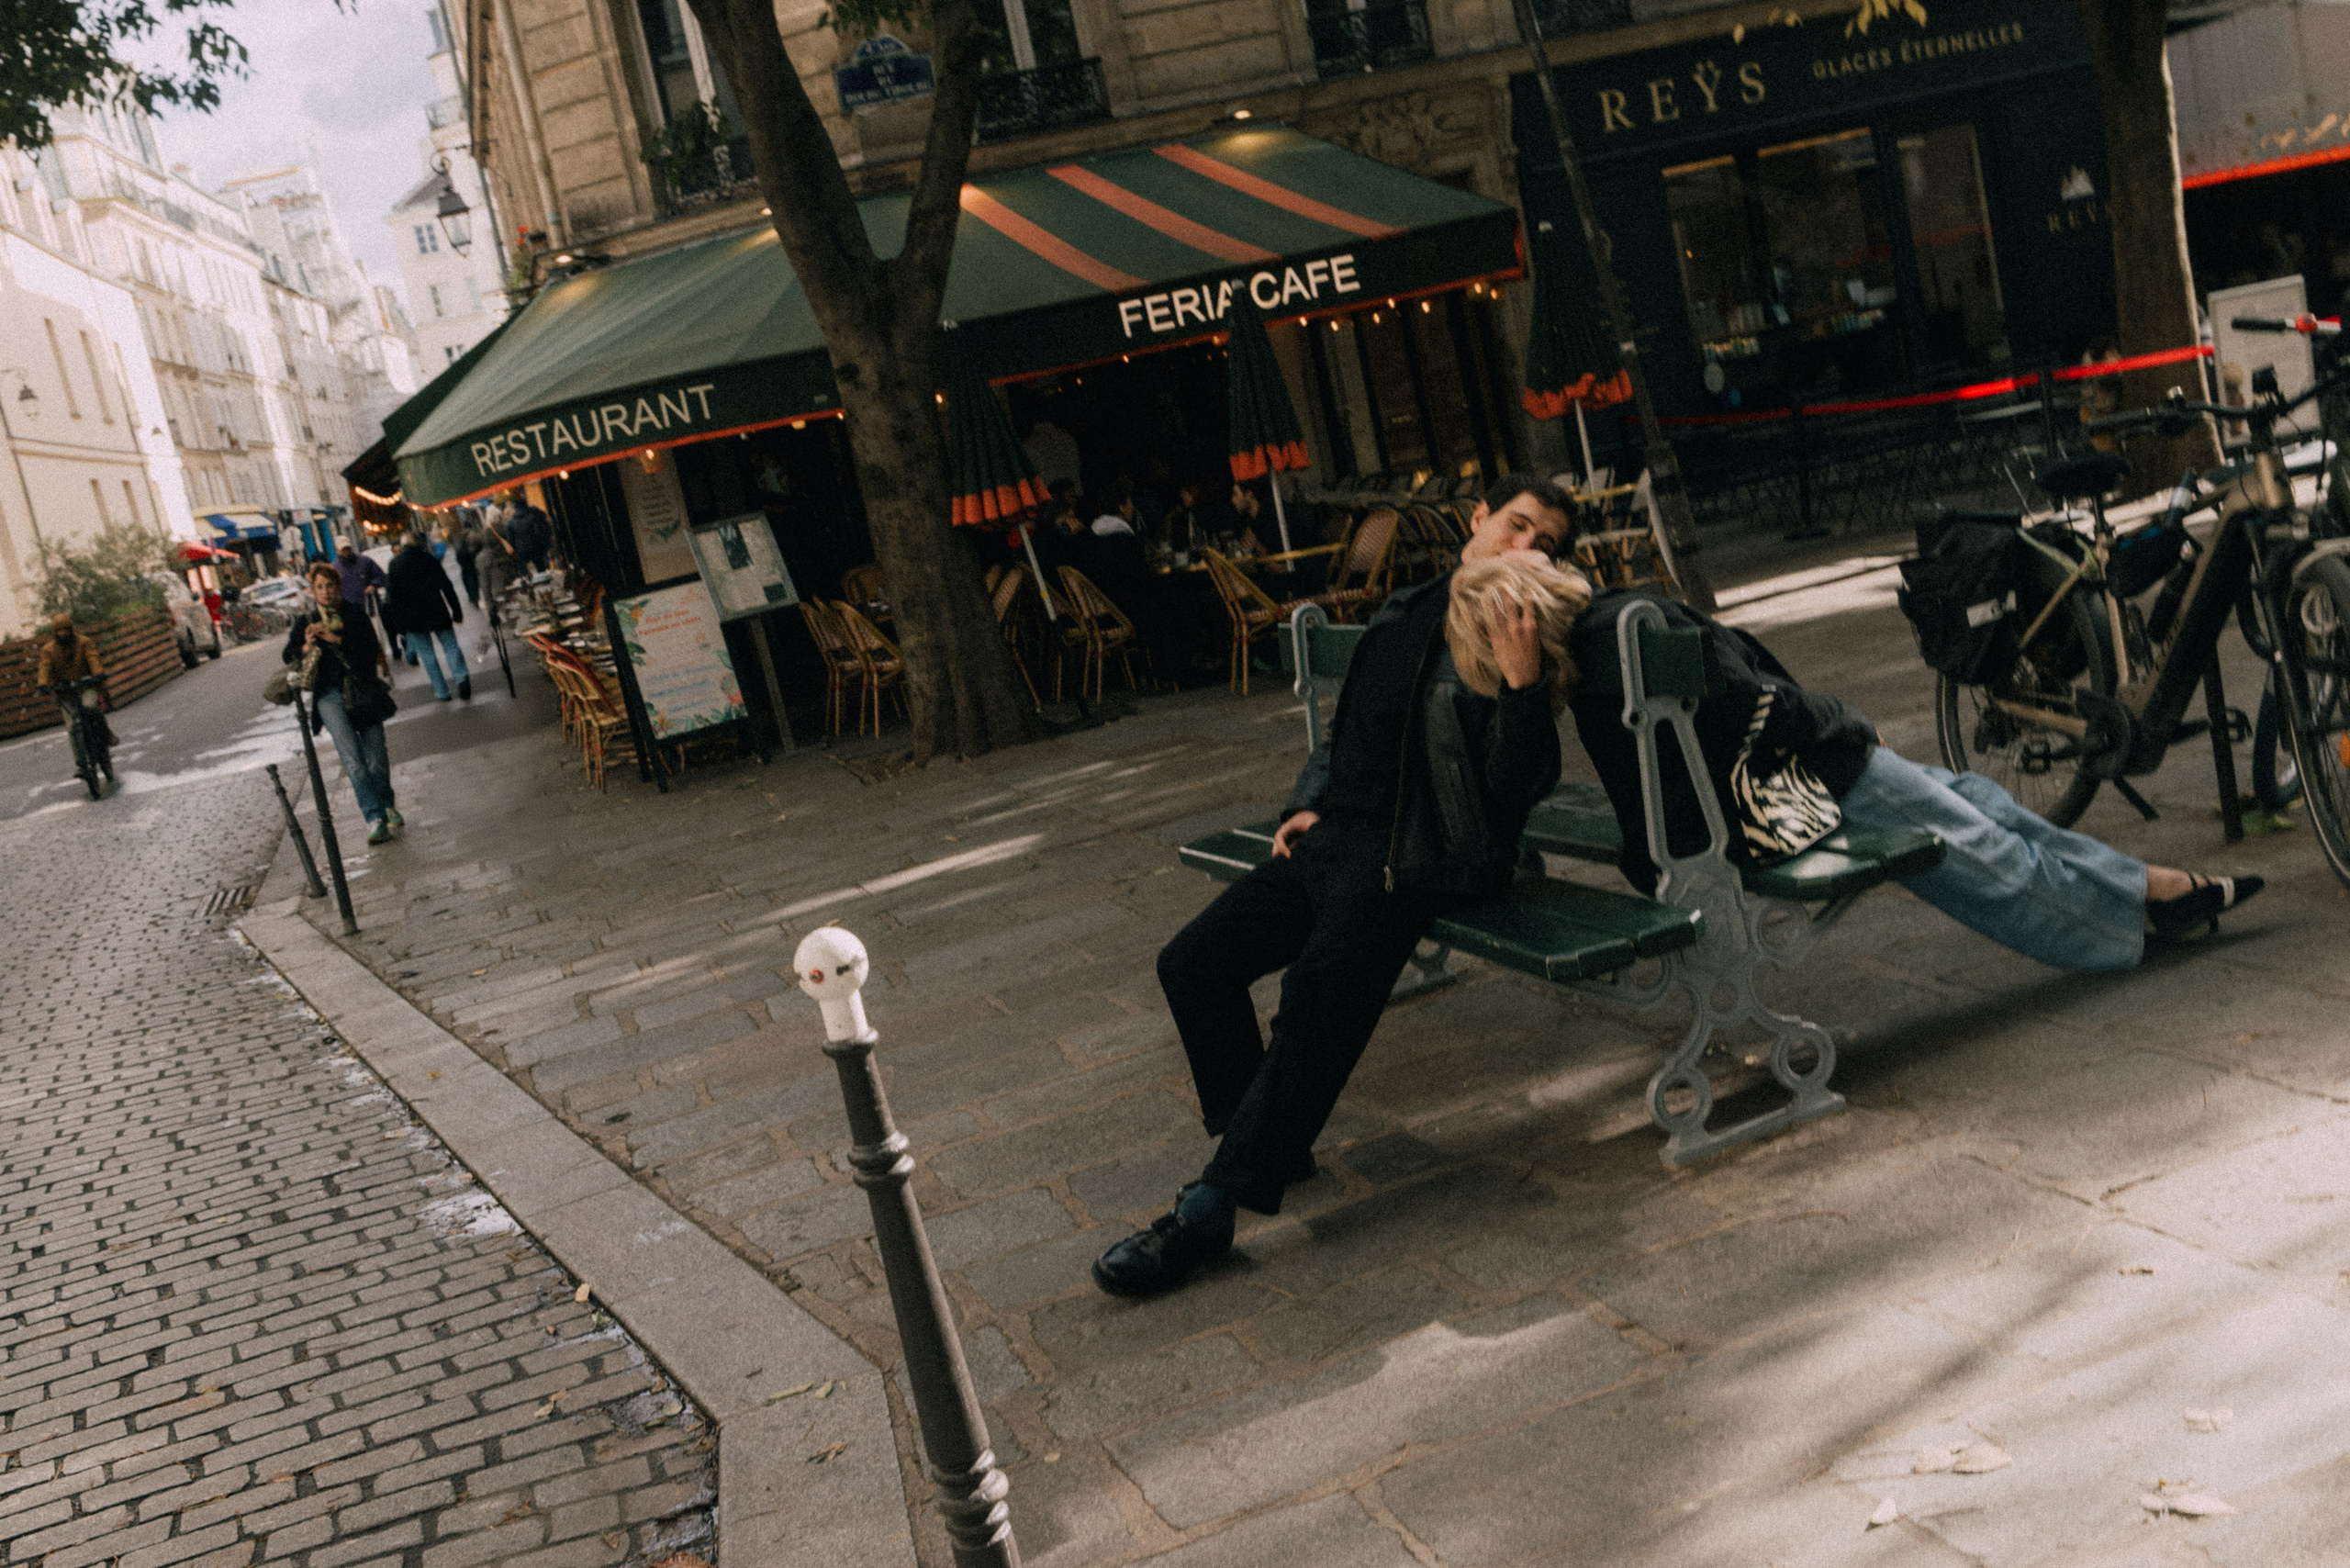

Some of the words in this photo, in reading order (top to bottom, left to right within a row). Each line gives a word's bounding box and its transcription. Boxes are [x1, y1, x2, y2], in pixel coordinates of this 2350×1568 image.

[1812, 48, 1893, 80] GLACES
[1118, 279, 1232, 339] FERIA
[1250, 253, 1361, 310] CAFE
[470, 384, 716, 476] RESTAURANT
